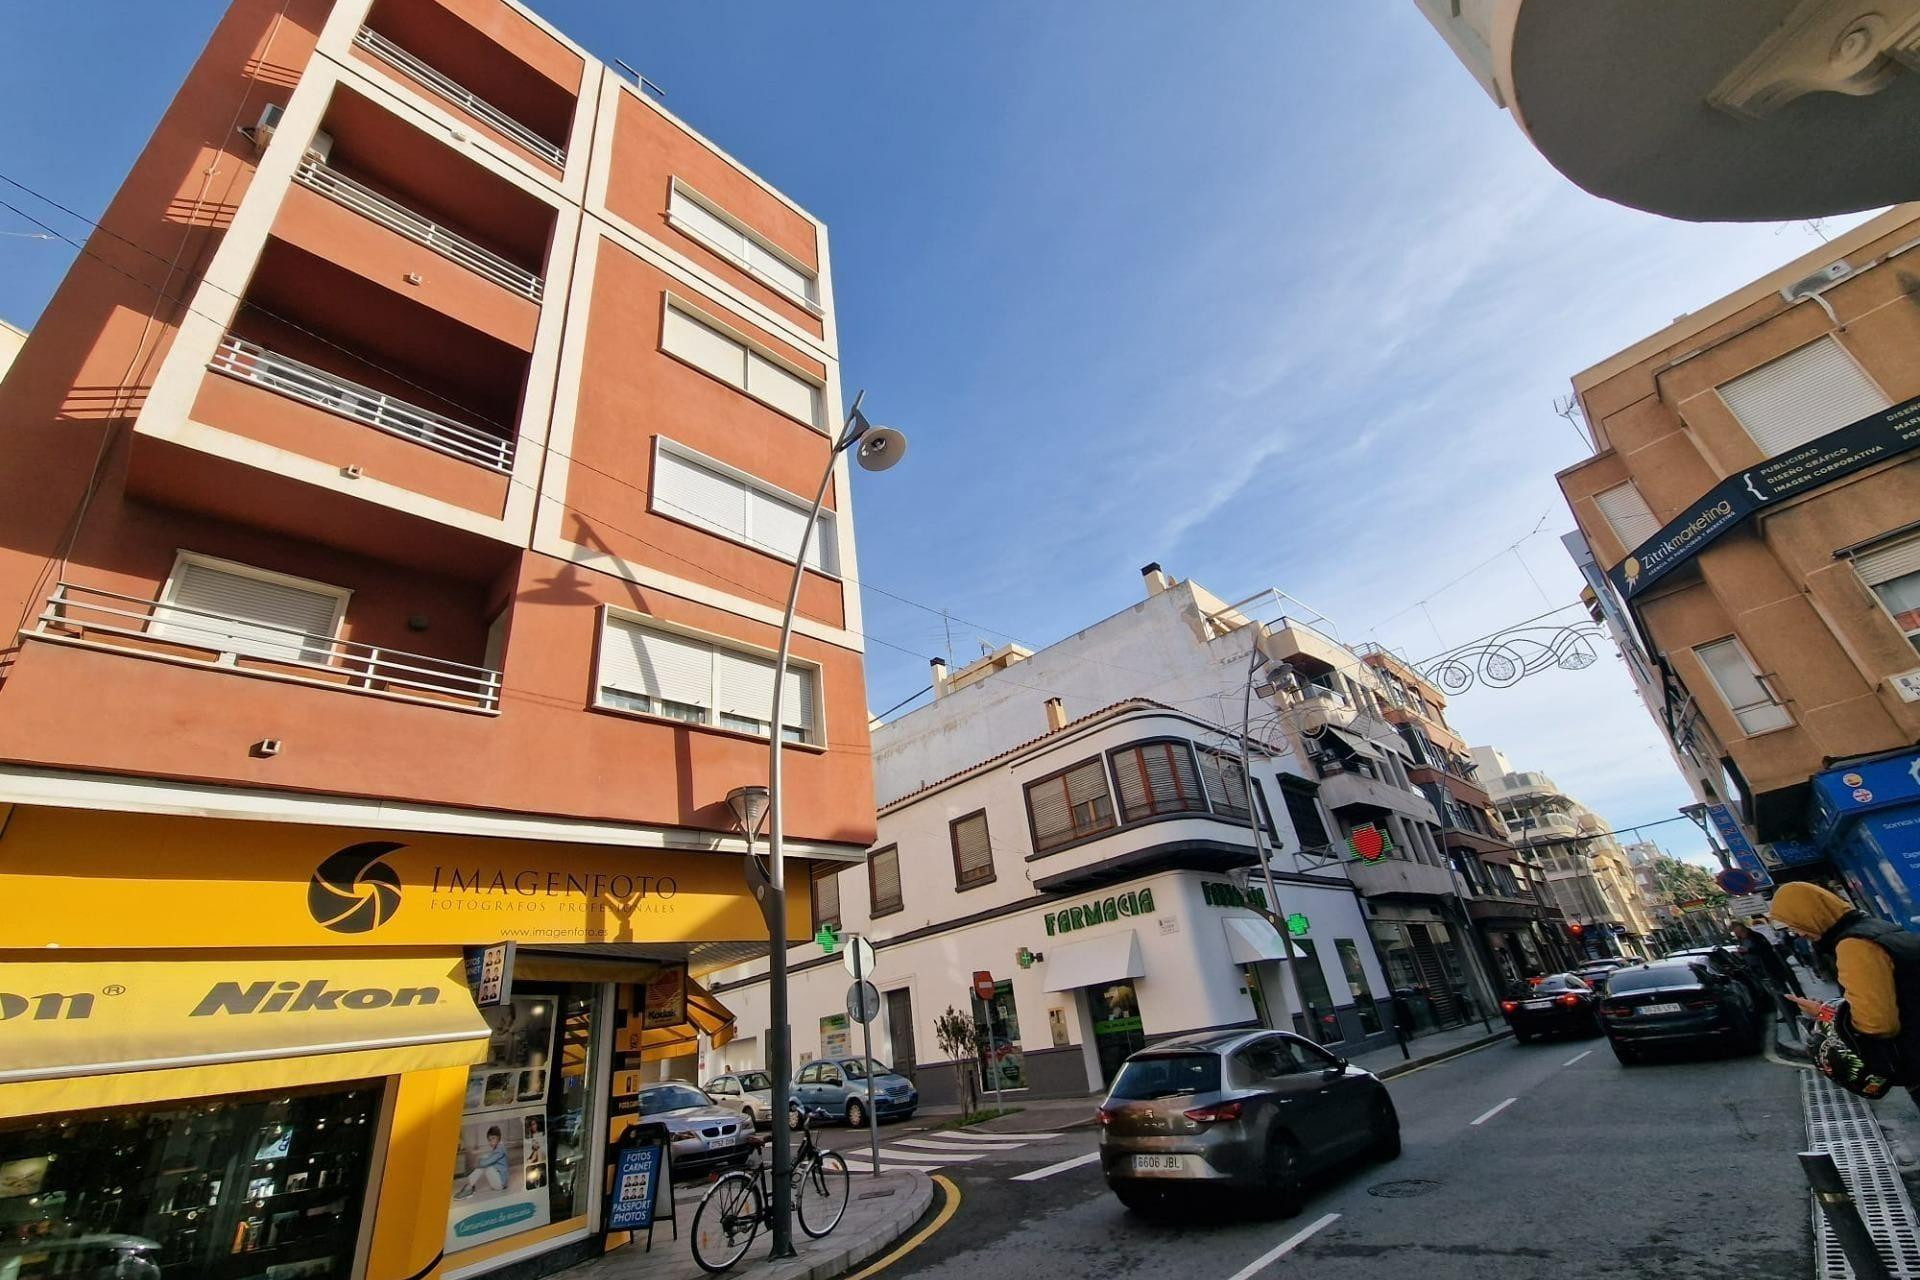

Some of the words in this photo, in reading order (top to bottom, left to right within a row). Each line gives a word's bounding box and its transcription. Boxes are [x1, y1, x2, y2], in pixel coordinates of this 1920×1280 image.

[1760, 448, 1818, 475] PUBLICIDAD
[1805, 447, 1848, 468] GRÁFICO
[1774, 474, 1812, 493] IMAGEN
[1813, 445, 1884, 477] CORPORATIVA
[1706, 511, 1736, 534] MARKETING
[1641, 500, 1731, 569] Zitrikmarketing
[432, 865, 677, 899] IMAGENFOTO
[559, 902, 675, 913] PROFESIONALES
[1044, 887, 1155, 936] FARMACIA
[500, 927, 608, 938] www.imagenfoto.es
[188, 980, 440, 1017] Nikon
[622, 1161, 652, 1172] CARNET
[626, 1151, 651, 1162] FOTOS
[613, 1200, 651, 1212] PASSPORT
[613, 1210, 647, 1222] PHOTOS
